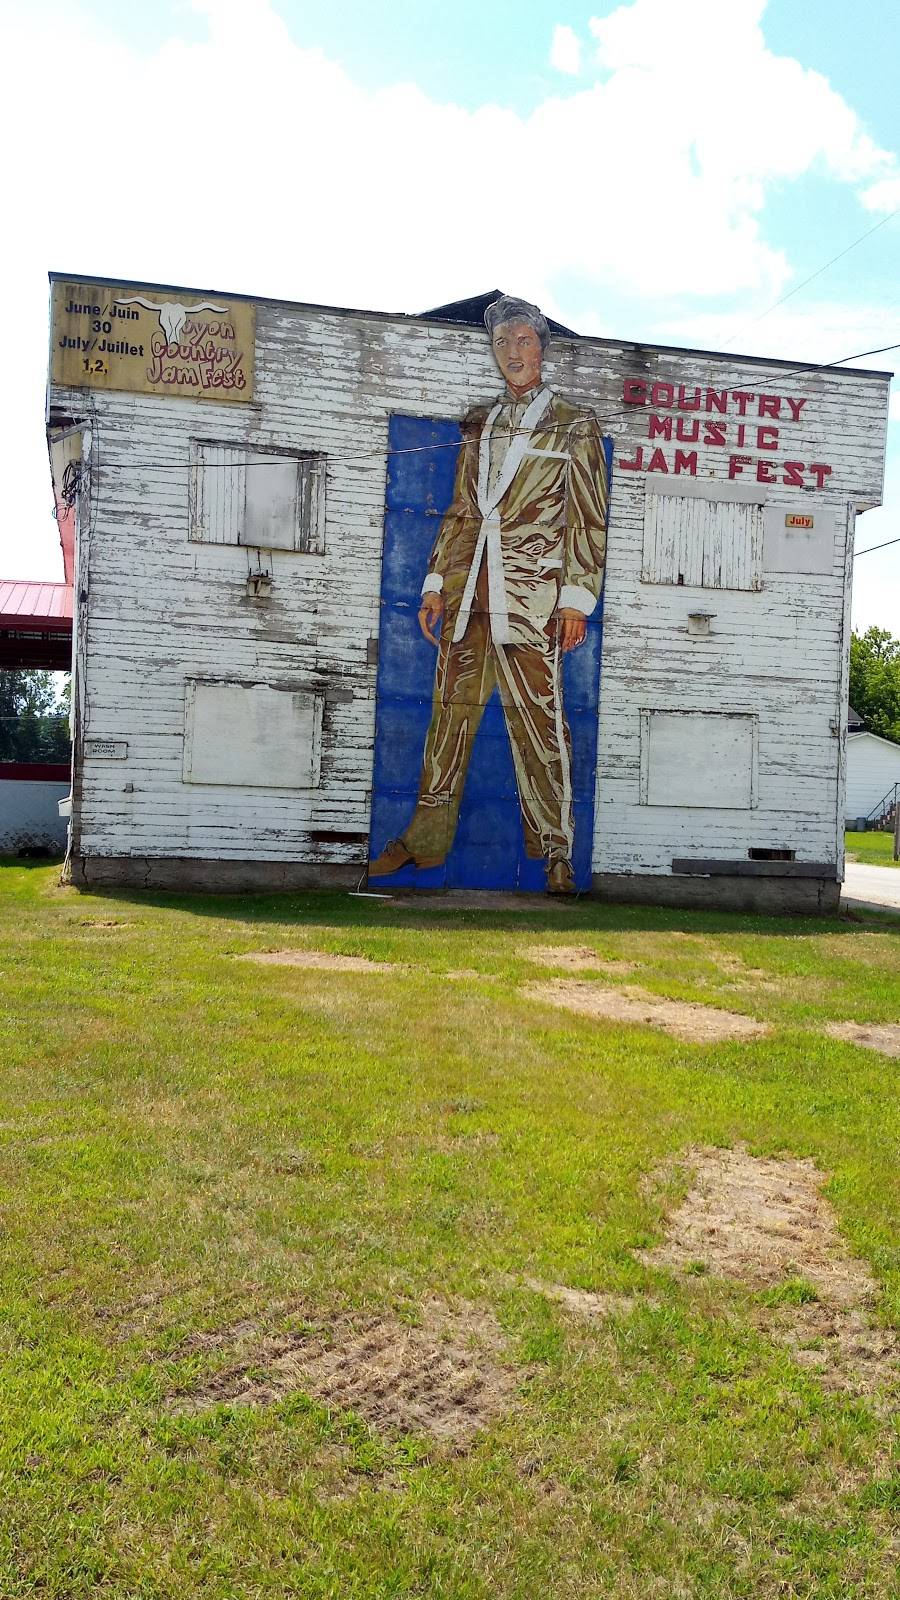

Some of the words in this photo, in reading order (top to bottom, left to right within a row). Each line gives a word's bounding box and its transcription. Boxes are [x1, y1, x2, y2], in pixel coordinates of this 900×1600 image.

[65, 301, 139, 320] June/Juin
[92, 320, 112, 334] 30
[59, 336, 144, 357] July/Juillet
[151, 331, 244, 372] Country
[622, 378, 807, 422] COUNTRY
[648, 415, 779, 450] MUSIC
[619, 446, 697, 476] JAM
[728, 455, 832, 488] FEST
[789, 516, 811, 527] July
